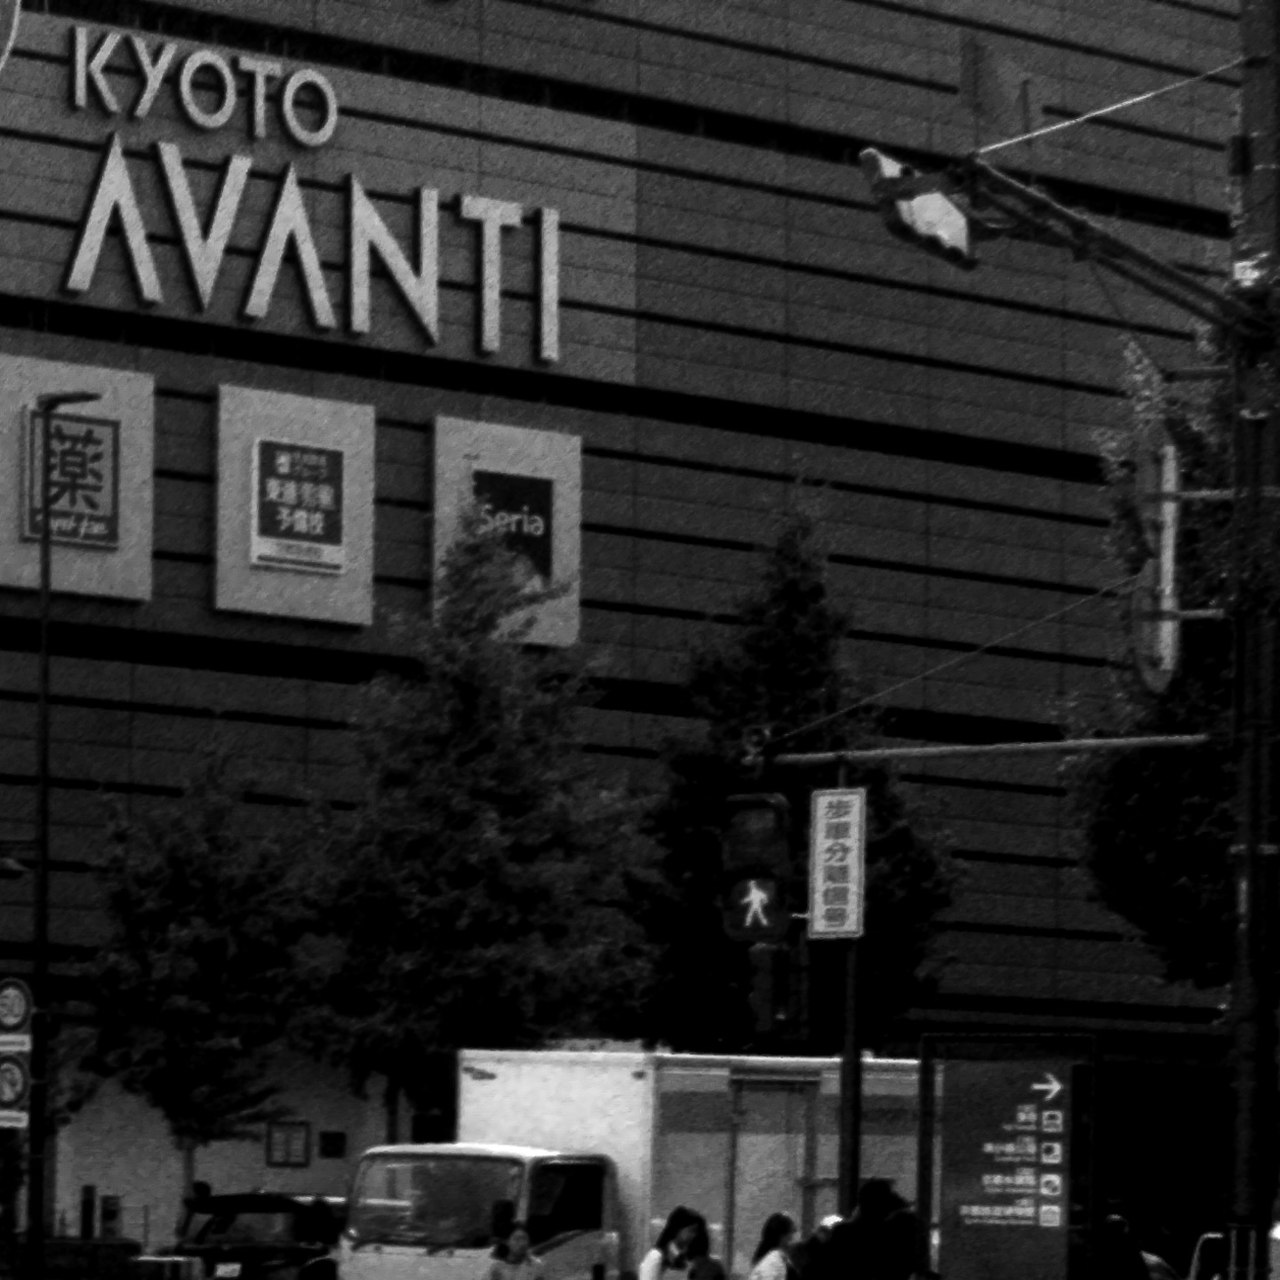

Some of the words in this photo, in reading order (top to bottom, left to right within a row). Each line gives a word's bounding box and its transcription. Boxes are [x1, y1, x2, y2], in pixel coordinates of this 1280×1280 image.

[73, 26, 339, 147] KYOTO
[66, 131, 561, 364] AVANTI
[46, 424, 104, 510] 薬
[476, 503, 545, 537] Seria
[822, 799, 853, 928] 歩車分離信号
